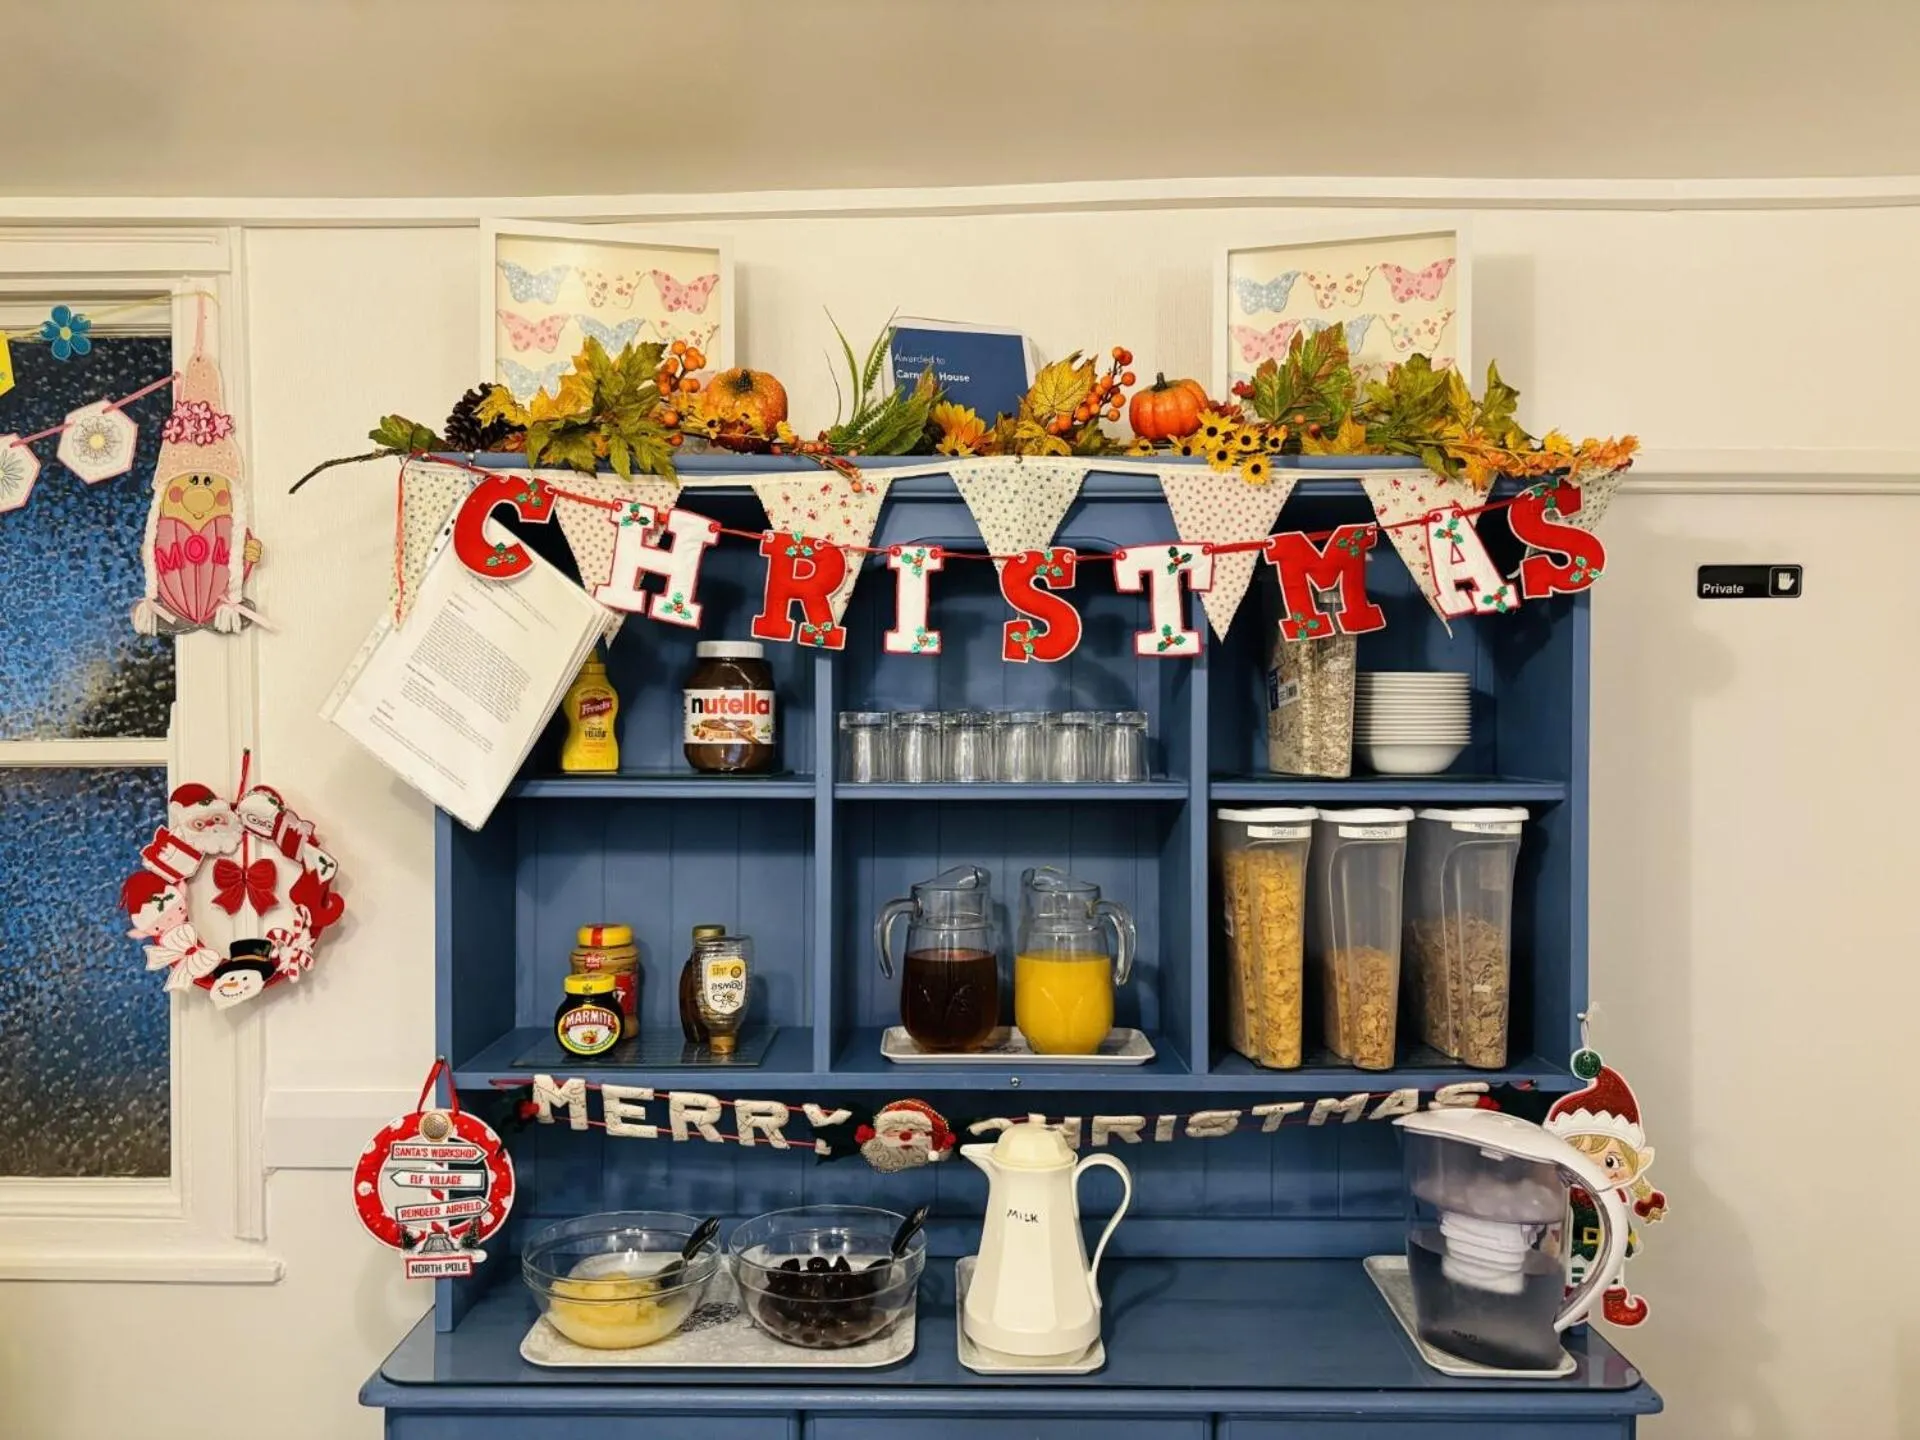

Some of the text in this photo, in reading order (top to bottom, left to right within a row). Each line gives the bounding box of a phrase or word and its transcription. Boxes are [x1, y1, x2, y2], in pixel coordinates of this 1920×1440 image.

[894, 353, 946, 365] Awarded to
[938, 371, 970, 383] House
[453, 475, 1608, 663] CHRISTMAS
[1702, 583, 1744, 594] Private
[691, 692, 770, 715] nutella
[565, 1009, 613, 1028] MARMITE
[533, 1074, 853, 1155] MERRY
[394, 1146, 477, 1158] SANTA'S WORKSHOP
[410, 1175, 462, 1185] ELF VILLAGE
[400, 1201, 482, 1218] REINDEER AIRFIELD
[1006, 1208, 1039, 1224] MILK
[411, 1262, 467, 1274] NORTH POLE
